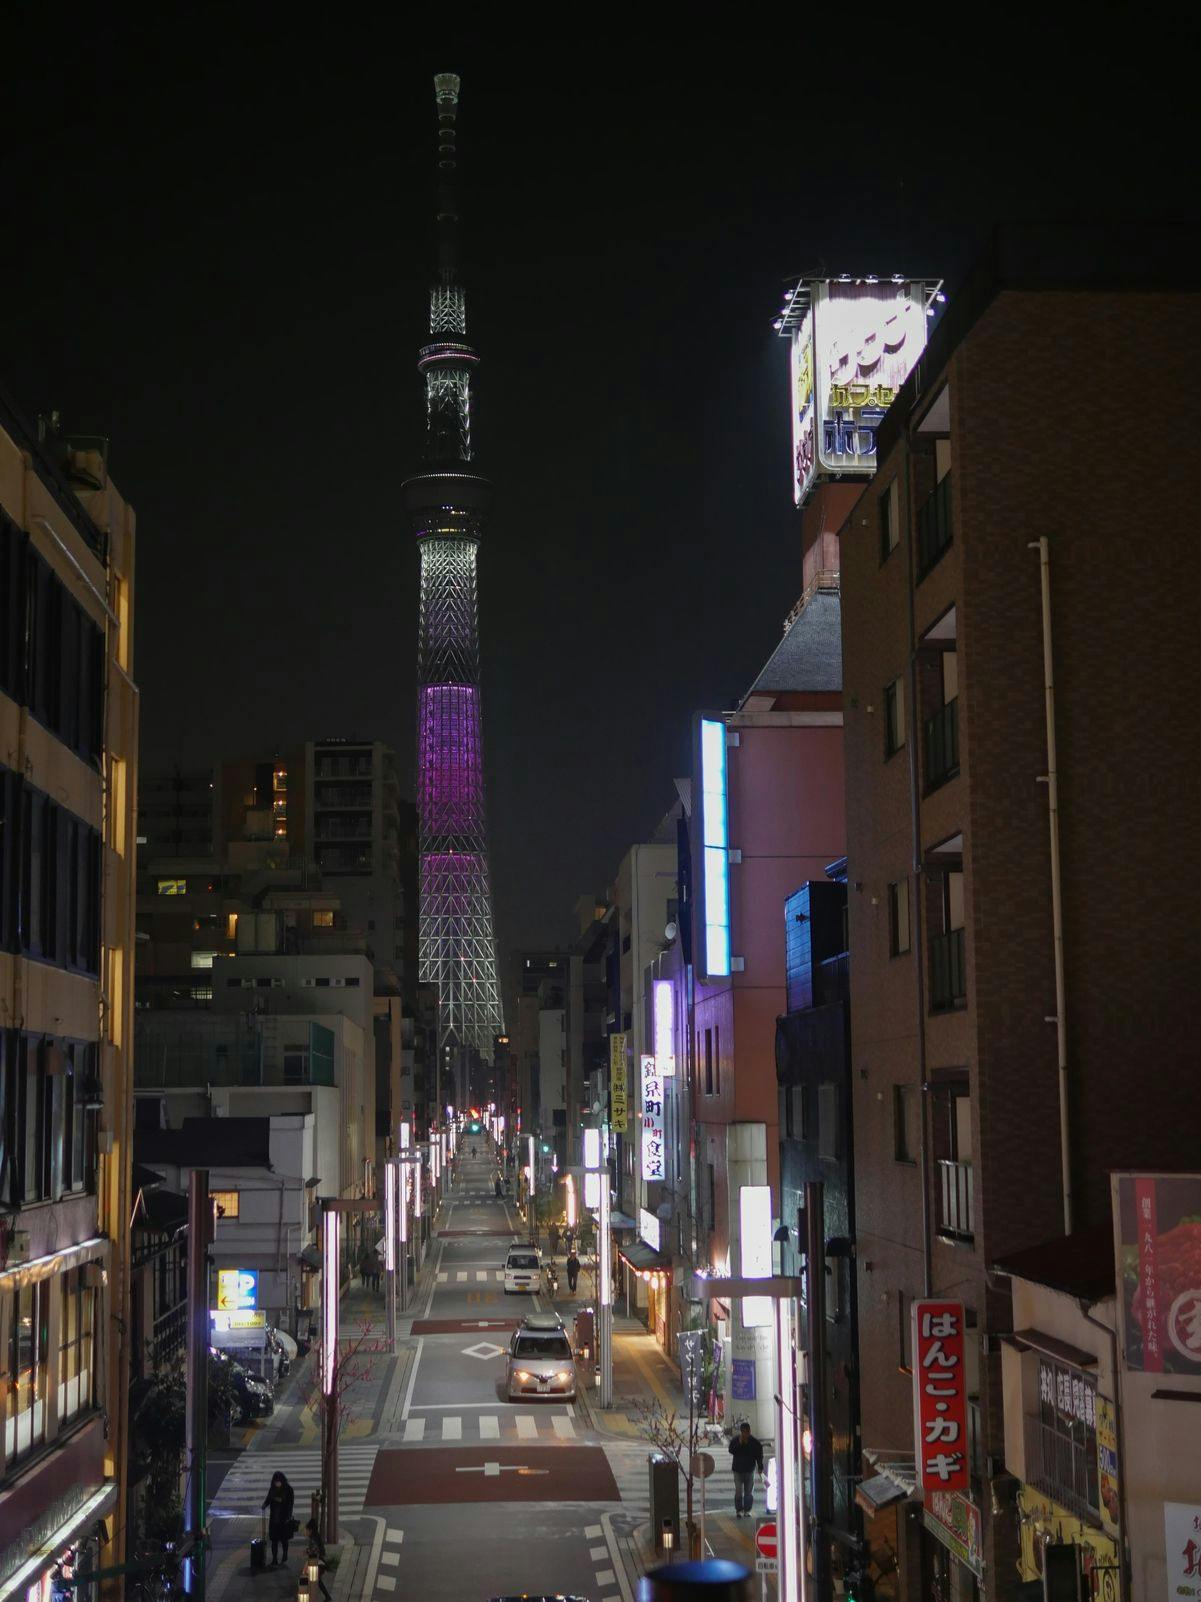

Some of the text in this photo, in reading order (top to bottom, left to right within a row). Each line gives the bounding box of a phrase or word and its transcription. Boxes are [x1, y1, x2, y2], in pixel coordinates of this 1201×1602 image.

[831, 384, 899, 408] カプセ
[922, 1312, 962, 1482] はんこ・カギ
